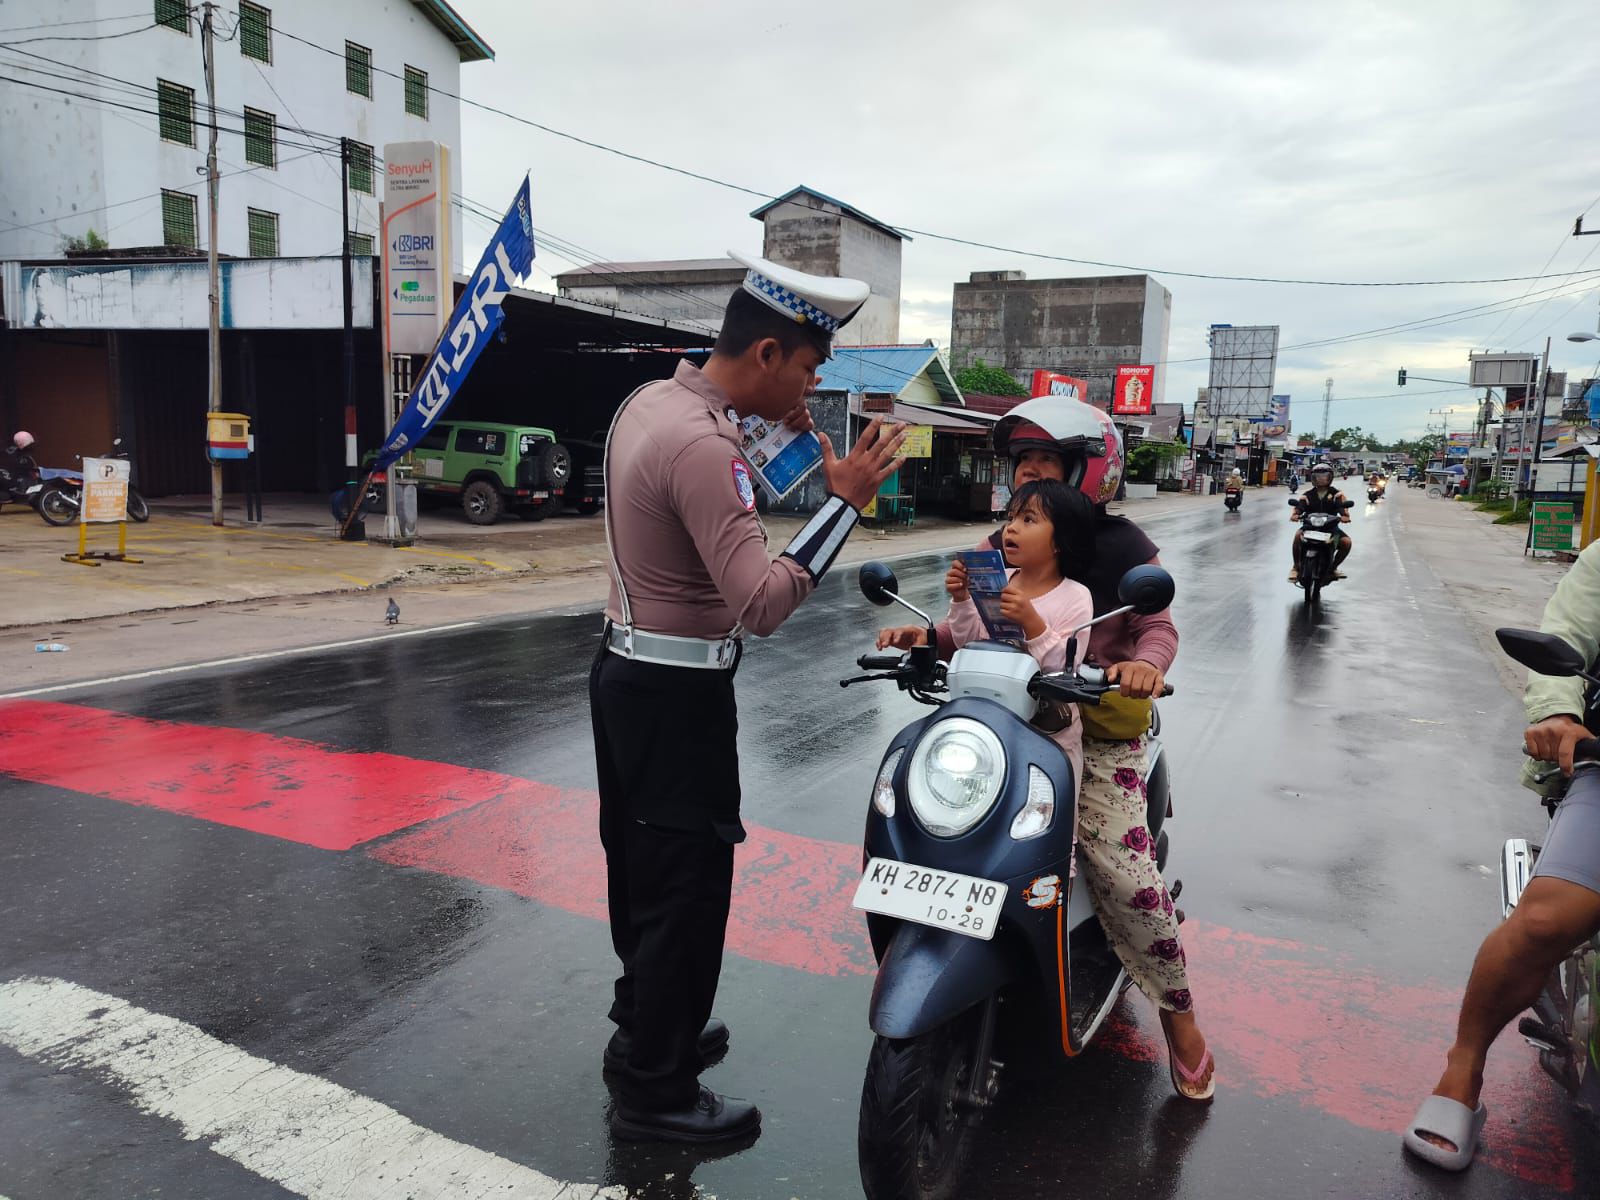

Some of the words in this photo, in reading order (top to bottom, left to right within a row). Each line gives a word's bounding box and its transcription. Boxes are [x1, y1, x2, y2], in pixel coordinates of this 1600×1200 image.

[413, 236, 434, 250] BRI
[400, 293, 436, 304] Pegadaian
[105, 465, 114, 477] P
[870, 863, 899, 886] KH
[903, 870, 959, 898] 2874
